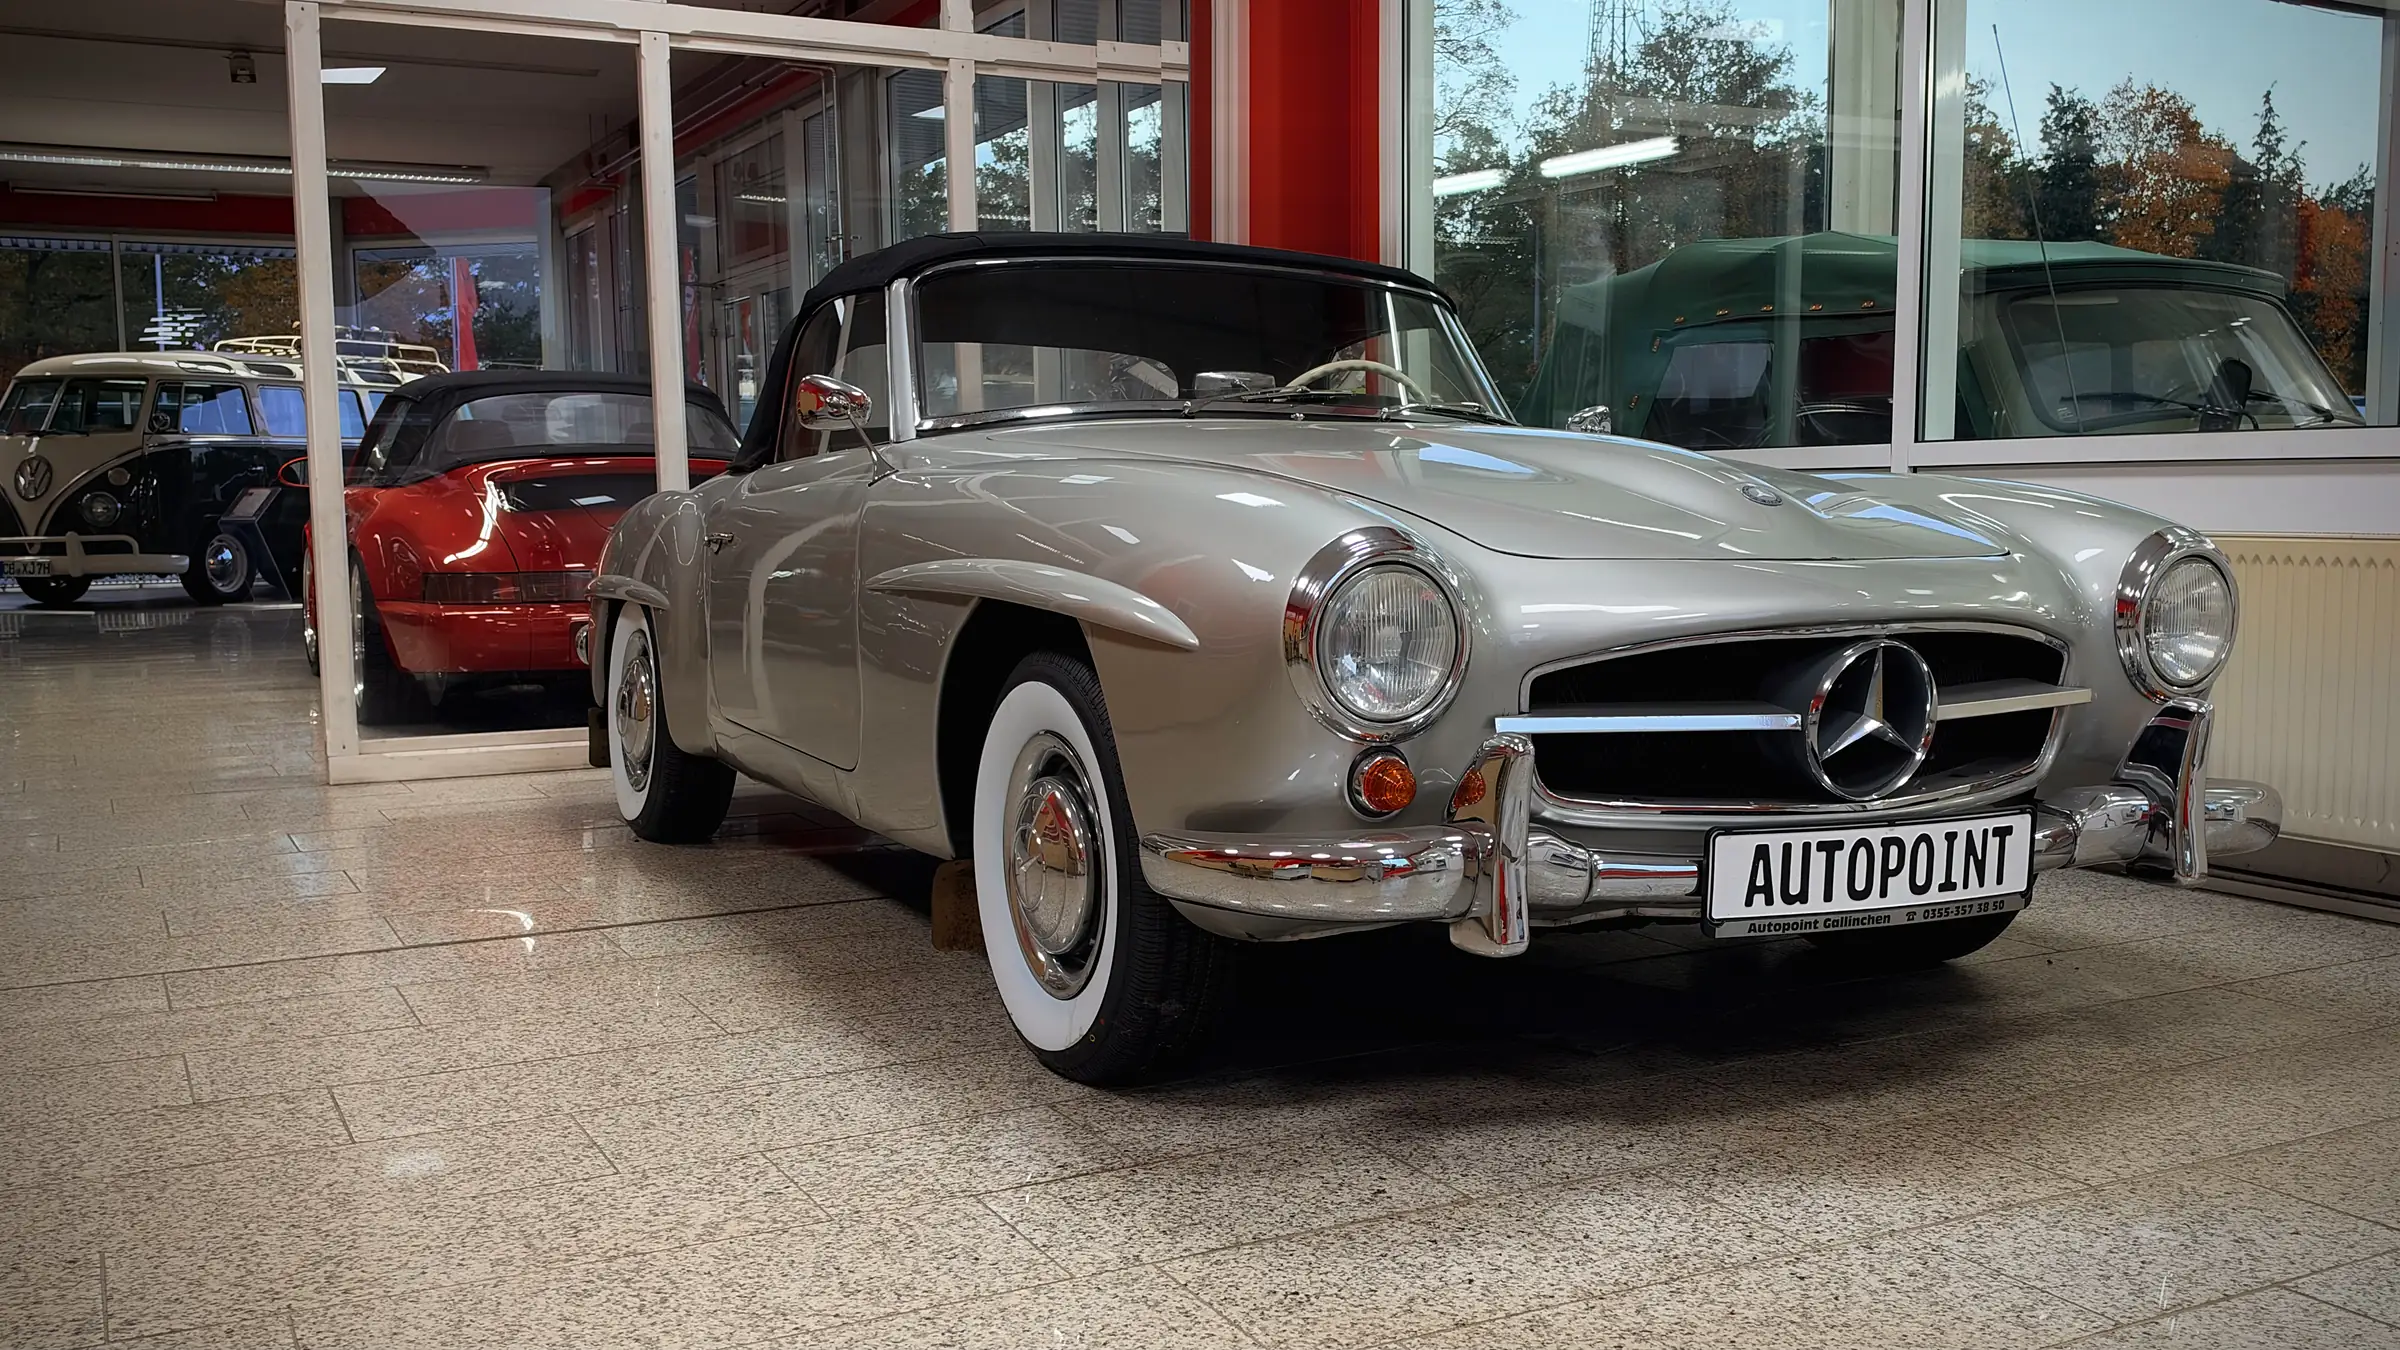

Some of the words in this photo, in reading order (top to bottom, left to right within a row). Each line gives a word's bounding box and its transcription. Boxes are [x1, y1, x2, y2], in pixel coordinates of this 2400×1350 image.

[1743, 824, 2014, 908] AUTOPOINT
[1747, 918, 1820, 933] Autopoint
[1823, 914, 1891, 929] Gallinchen
[1922, 904, 1974, 920] 0355-357
[1976, 902, 1990, 913] 38
[1992, 899, 2005, 911] 50
